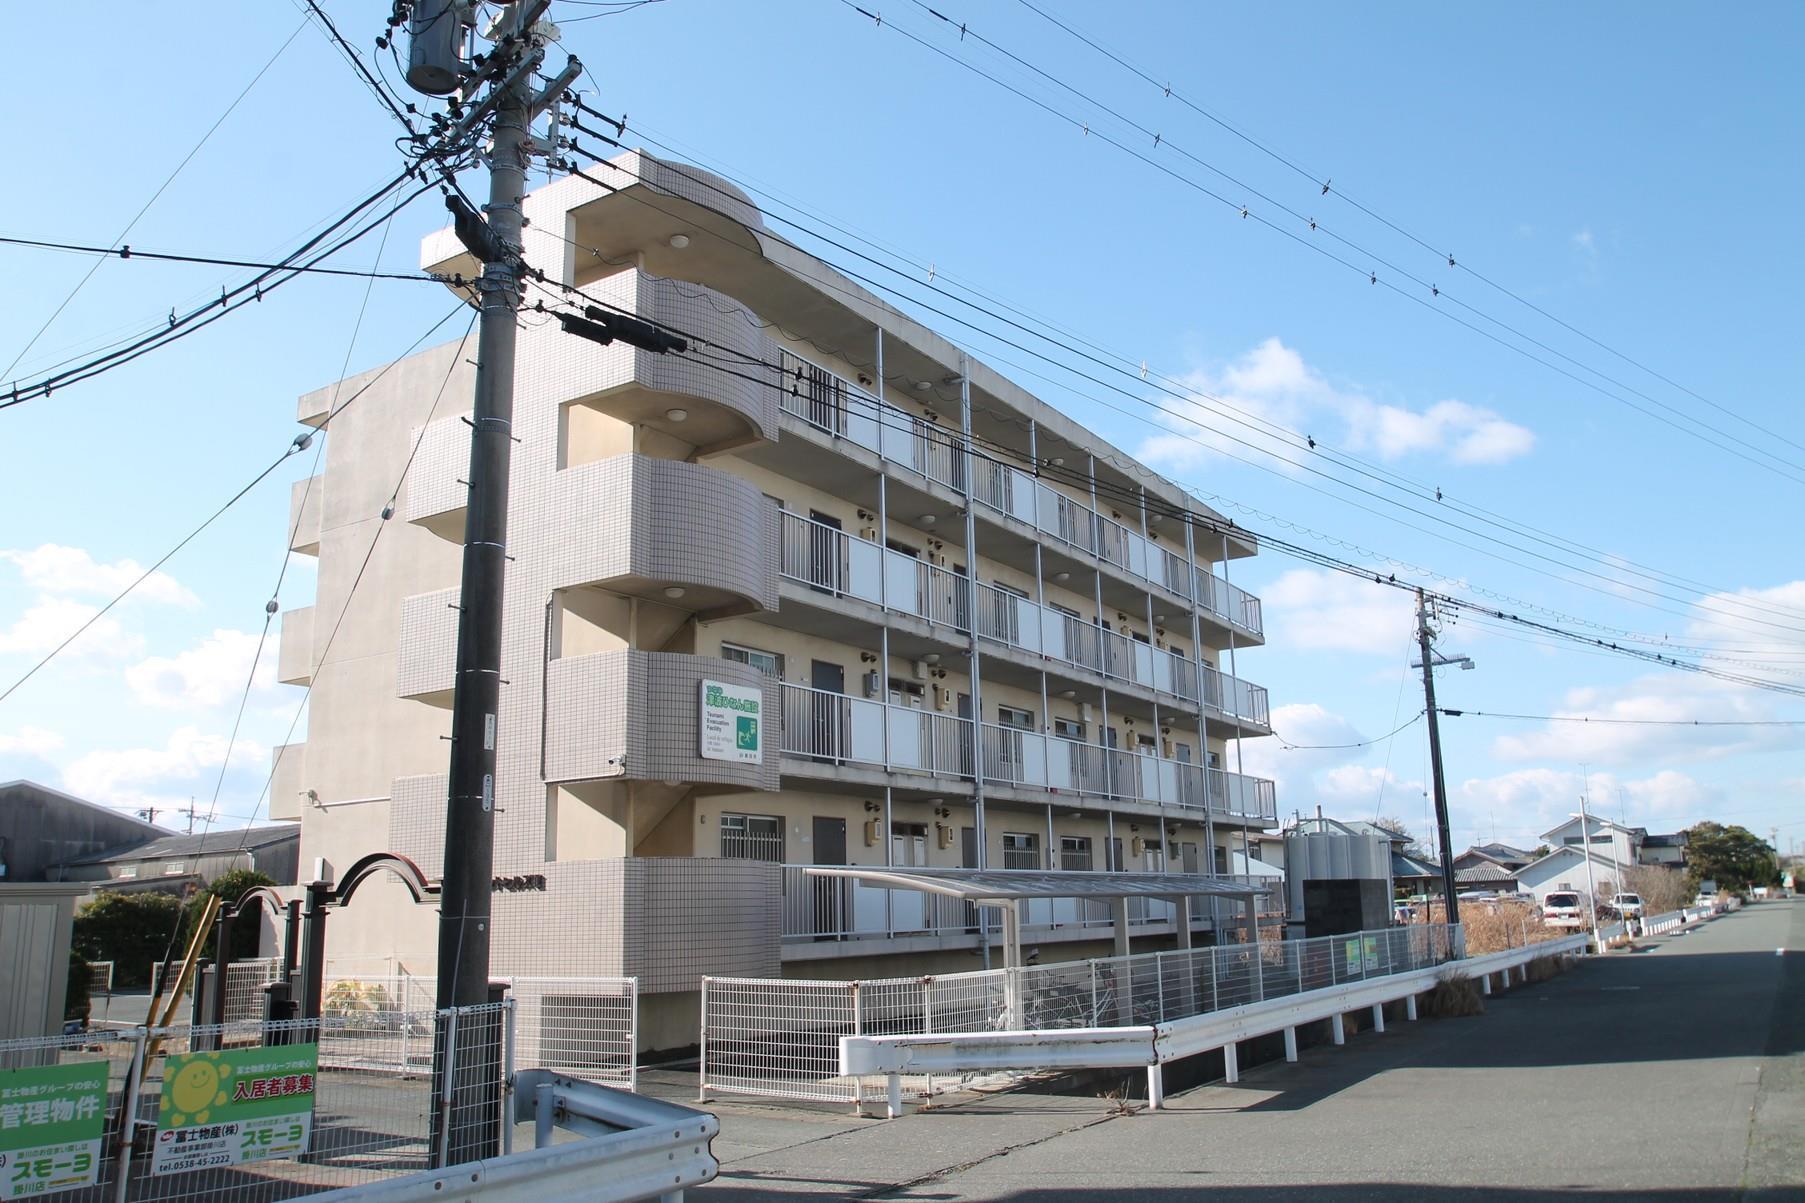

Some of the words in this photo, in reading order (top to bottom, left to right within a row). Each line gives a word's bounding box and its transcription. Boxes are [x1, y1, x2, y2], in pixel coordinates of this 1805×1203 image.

[232, 1072, 313, 1102] 入居者募集
[0, 1094, 99, 1129] 管理物件
[160, 1154, 230, 1172] tel.0538-45-2222
